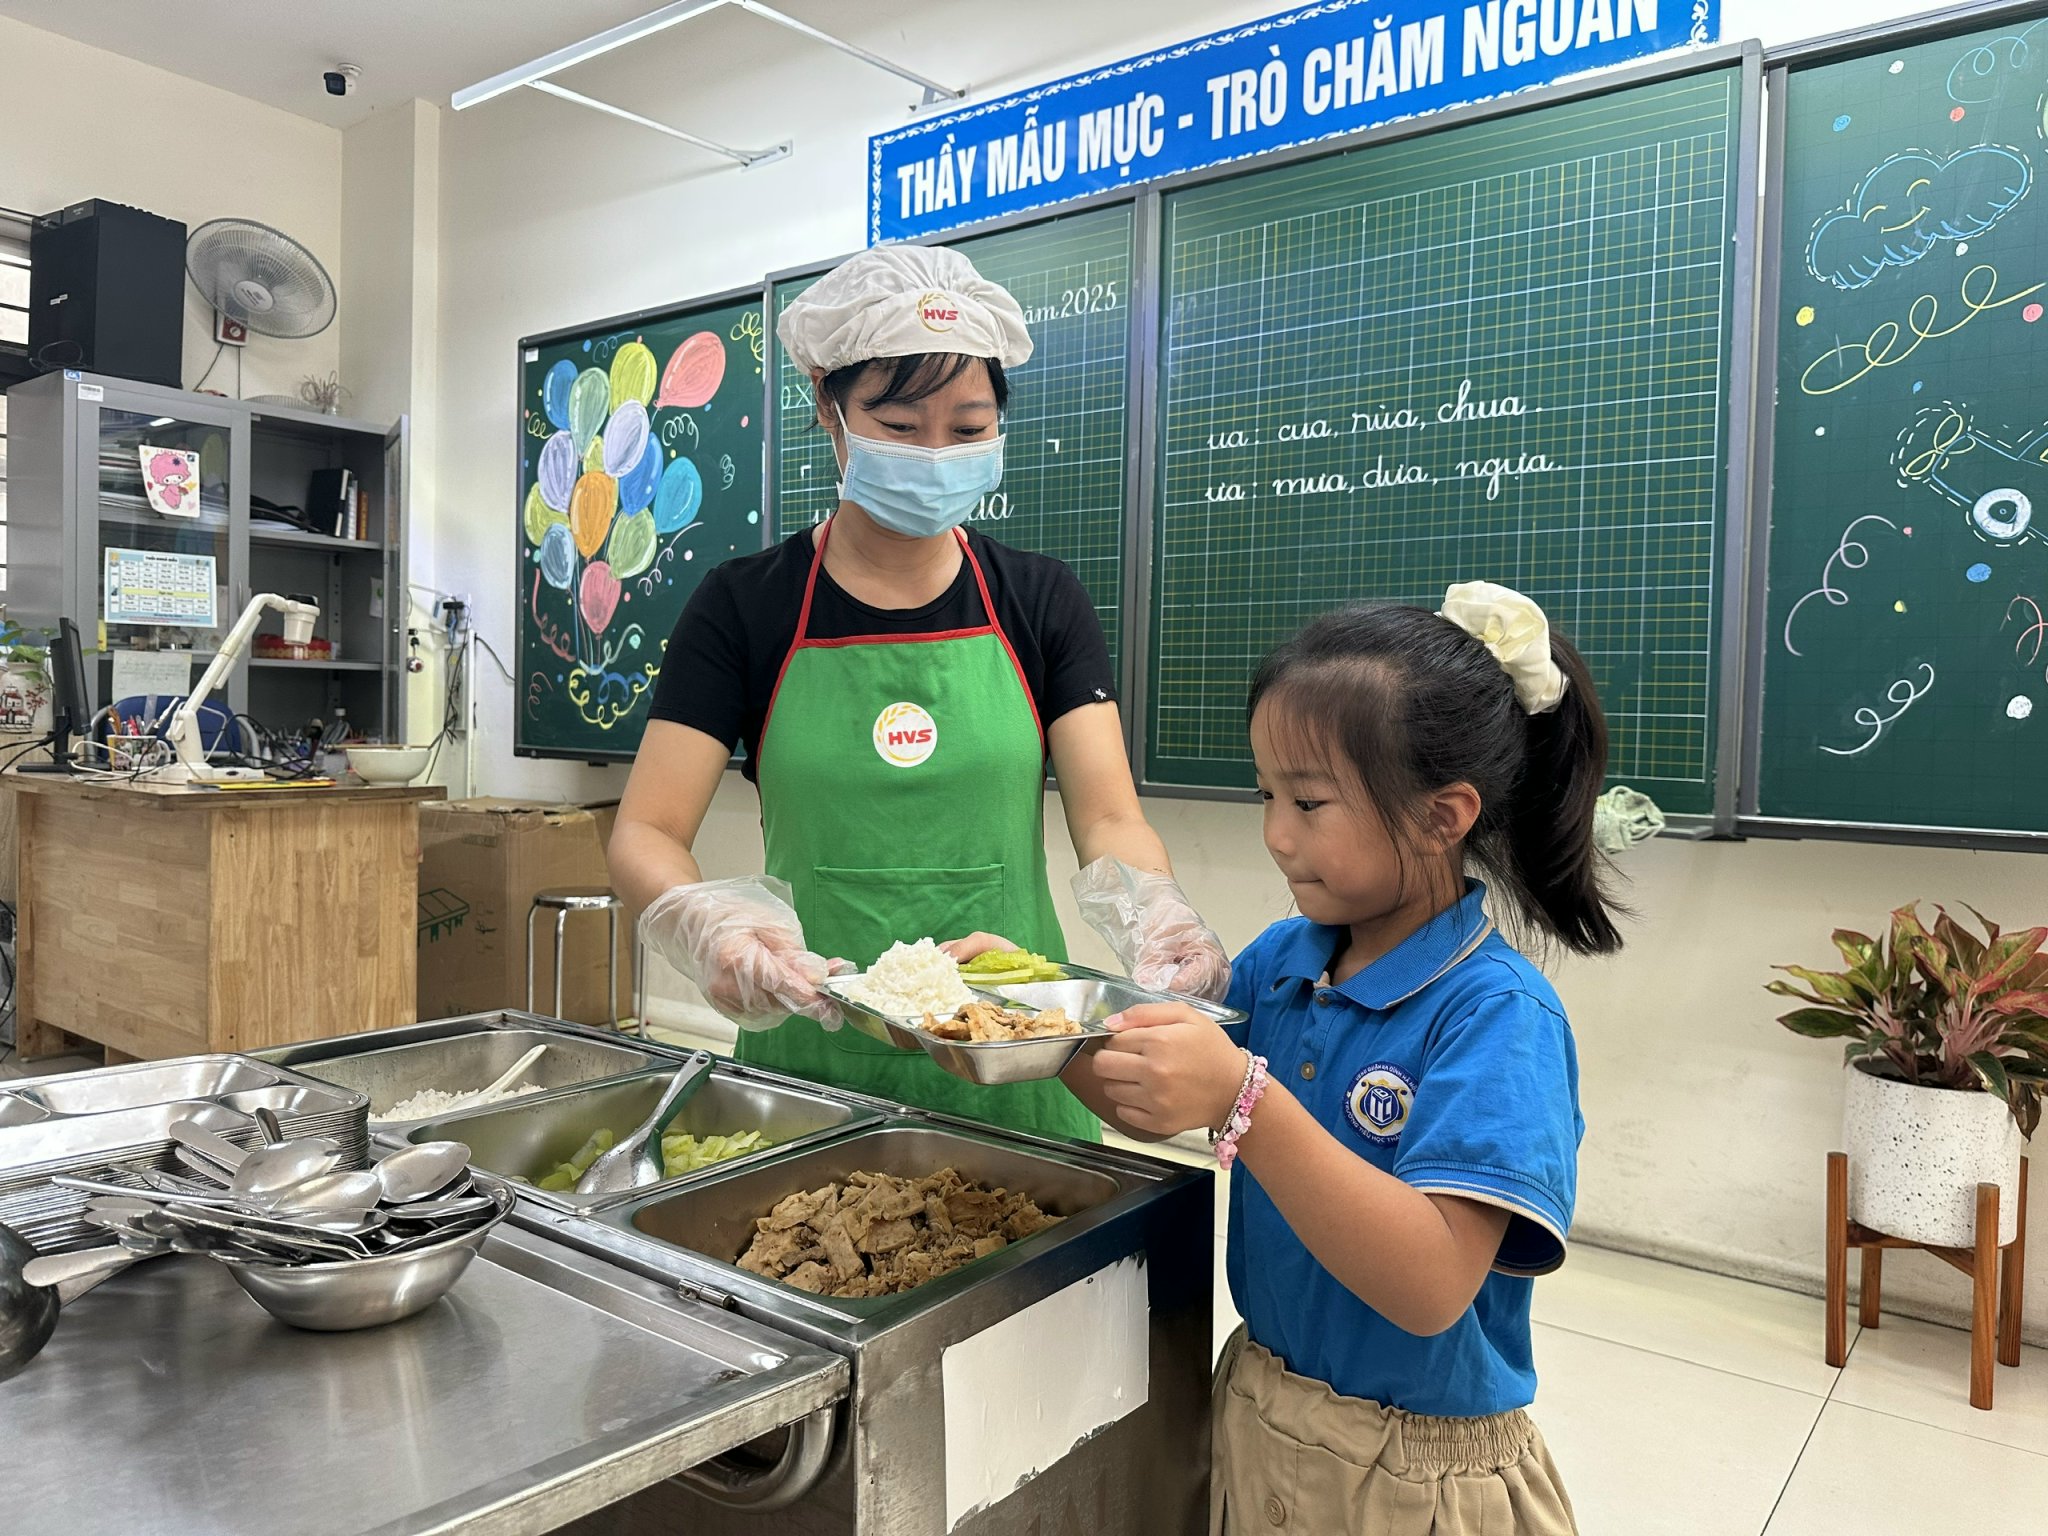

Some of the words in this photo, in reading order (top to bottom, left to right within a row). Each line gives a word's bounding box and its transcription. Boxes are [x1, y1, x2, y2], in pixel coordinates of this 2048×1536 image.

[896, 133, 978, 219] THẦY
[986, 105, 1067, 198] MẪU
[1077, 91, 1166, 177] MỰC
[1206, 44, 1289, 140] TRÒ
[1302, 14, 1445, 117] CHĂM
[923, 308, 959, 321] HVS
[888, 729, 933, 746] HVS
